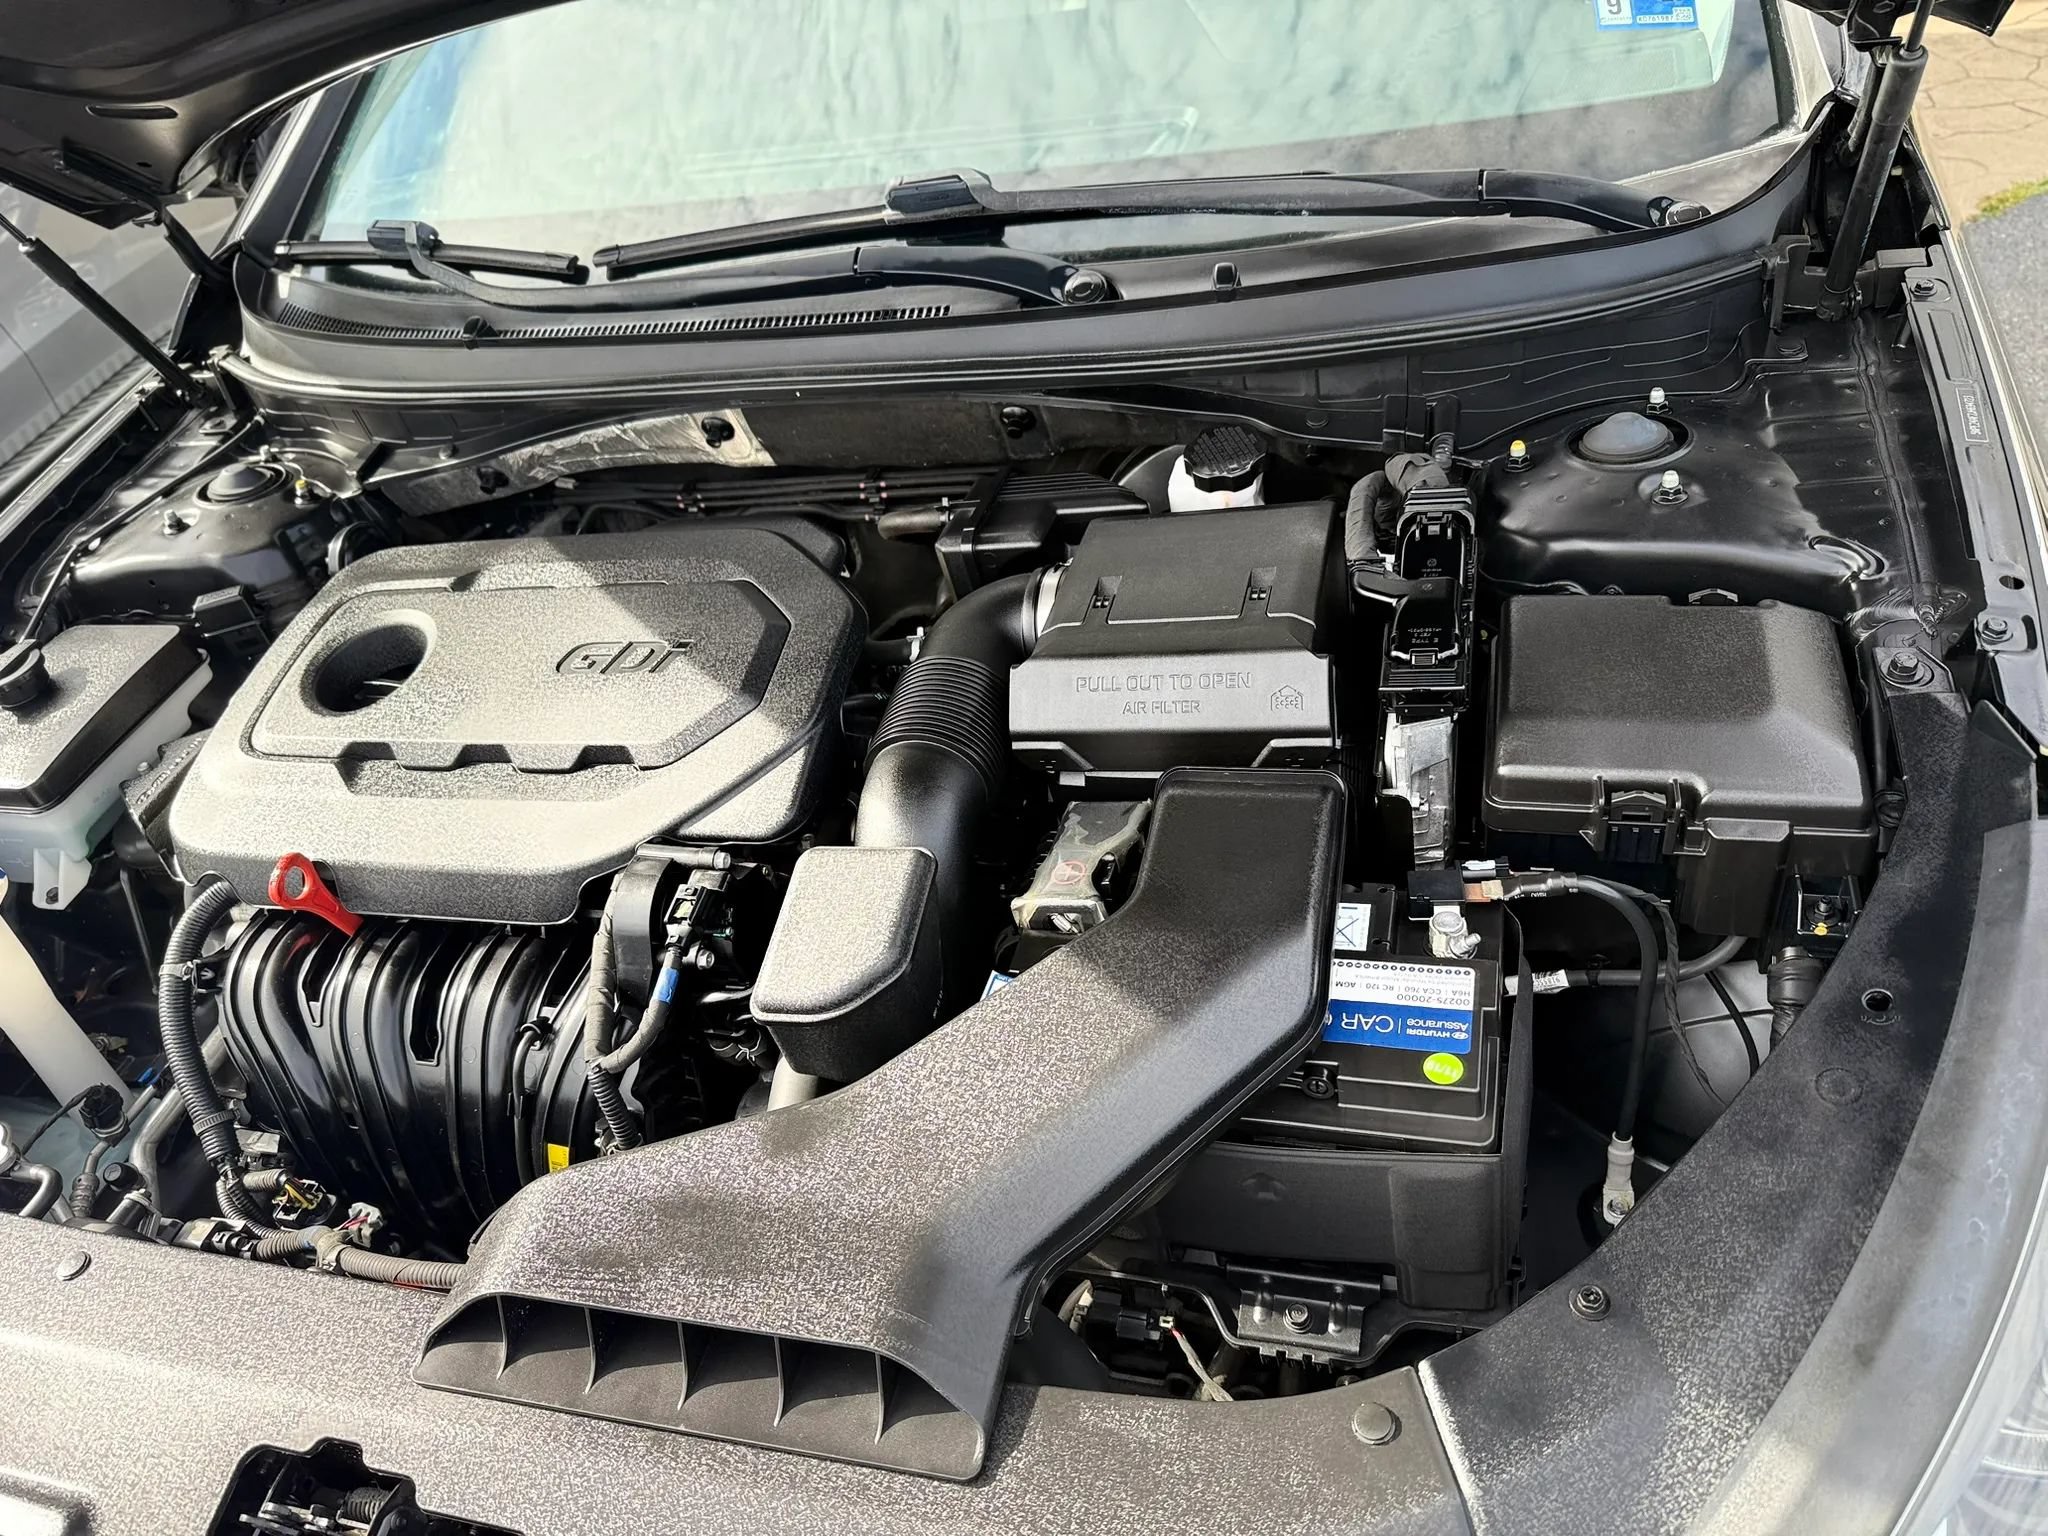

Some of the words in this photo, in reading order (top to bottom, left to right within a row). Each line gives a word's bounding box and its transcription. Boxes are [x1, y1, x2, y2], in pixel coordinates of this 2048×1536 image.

[1076, 676, 1122, 692] PULL
[1126, 674, 1164, 691] OUT
[1169, 673, 1193, 690] TO
[1199, 672, 1251, 689] OPEN
[1122, 700, 1147, 715] AIR
[1151, 700, 1201, 714] FILTER
[1335, 980, 1357, 988] AGM
[1422, 987, 1442, 995] CCA
[1396, 993, 1470, 1006] 00275-20000
[1341, 1012, 1394, 1033] CAR
[1406, 1018, 1469, 1031] Assurance
[1406, 1028, 1451, 1038] HYUNDAI
